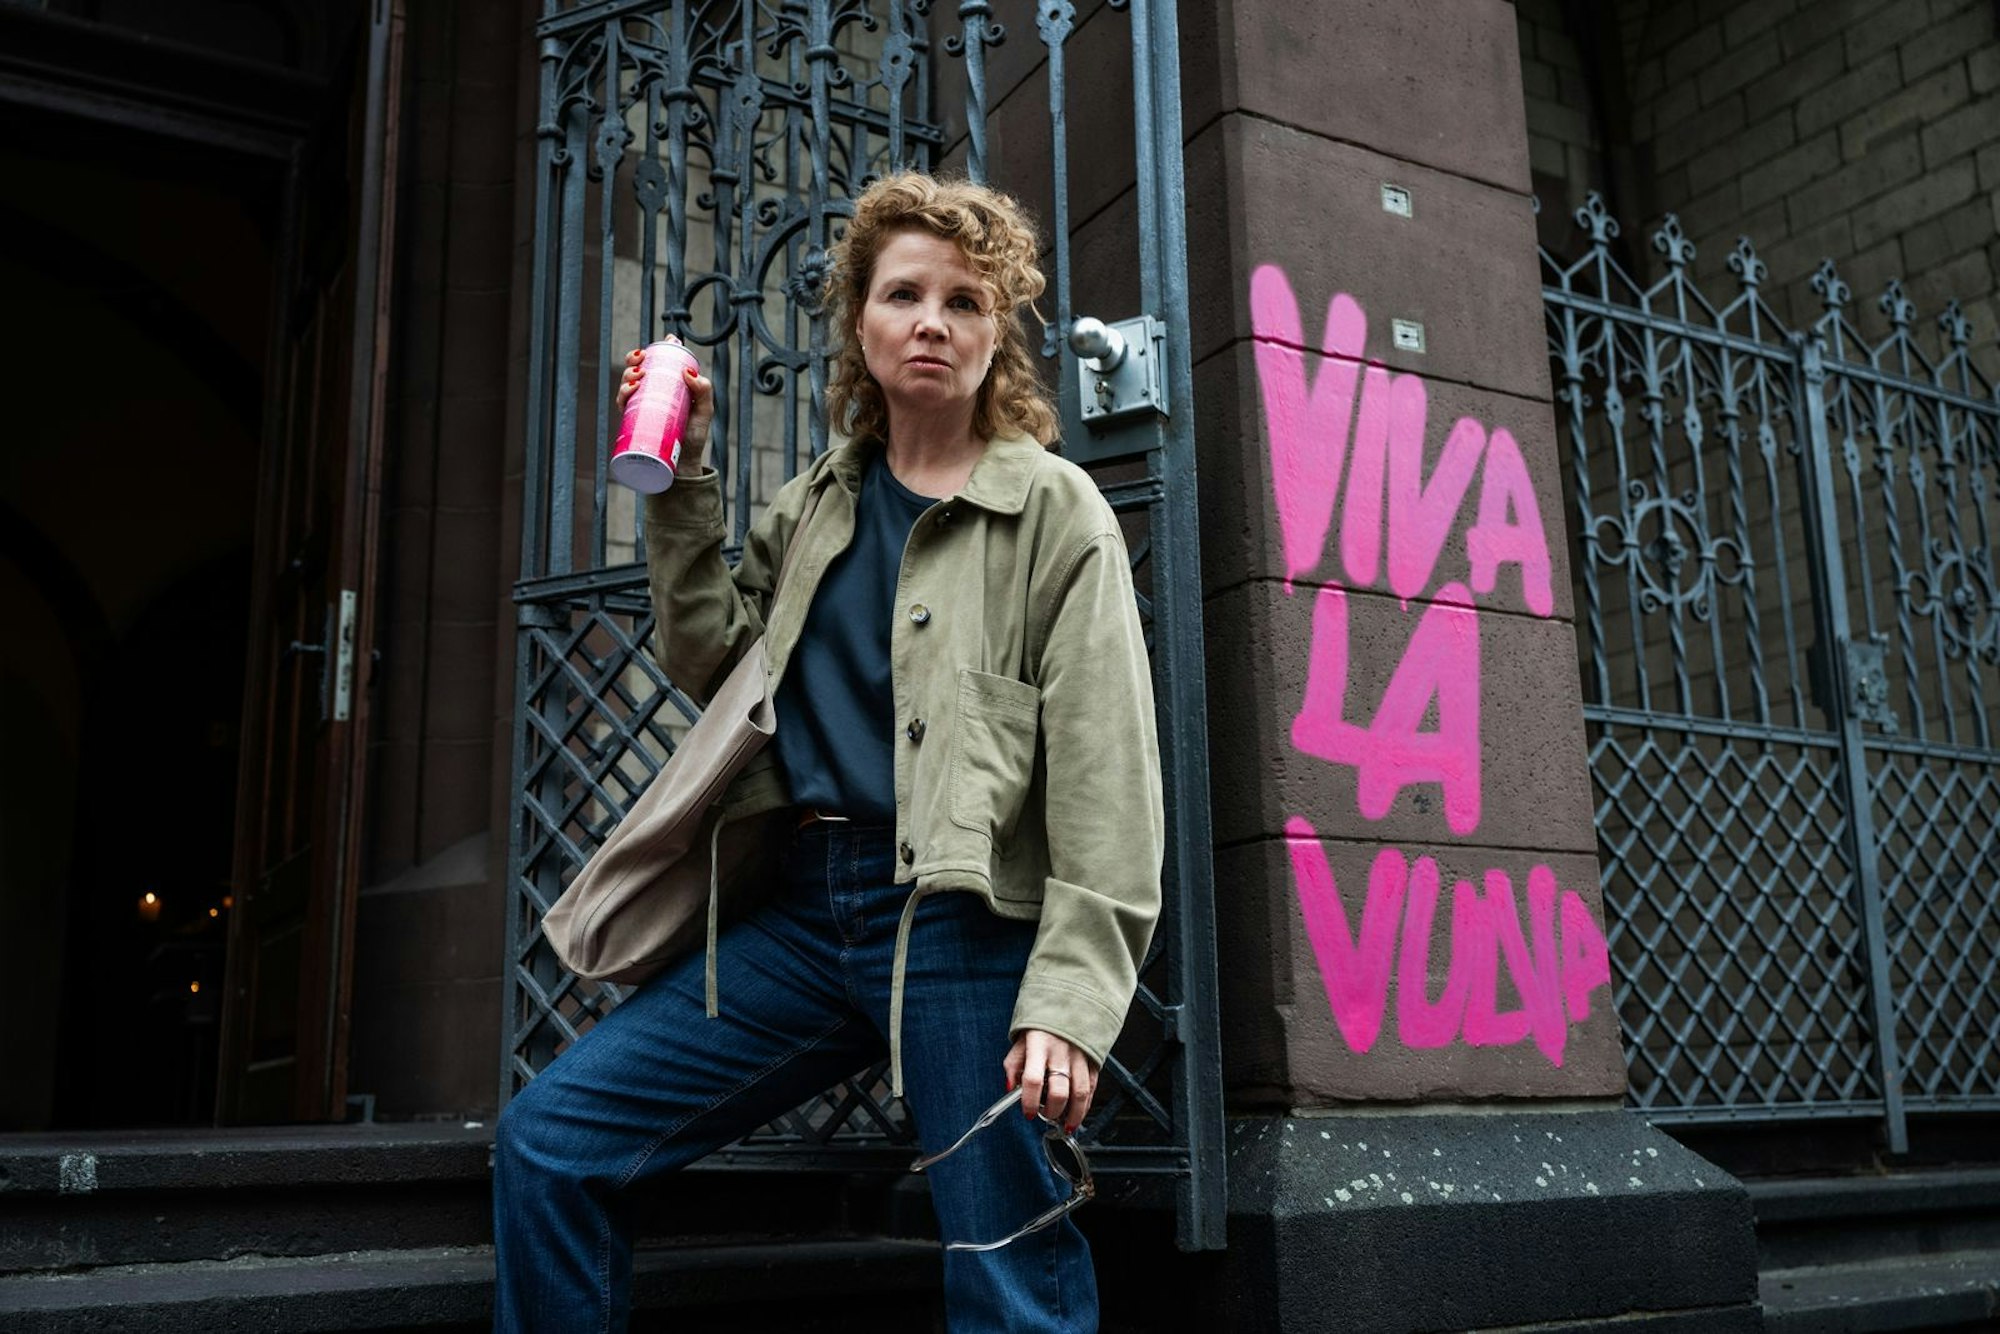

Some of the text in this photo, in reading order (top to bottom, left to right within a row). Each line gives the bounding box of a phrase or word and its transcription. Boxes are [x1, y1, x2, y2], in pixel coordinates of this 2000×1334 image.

[1250, 264, 1553, 617] VIVA
[1291, 582, 1481, 836] LA
[1285, 815, 1610, 1067] VULVA
